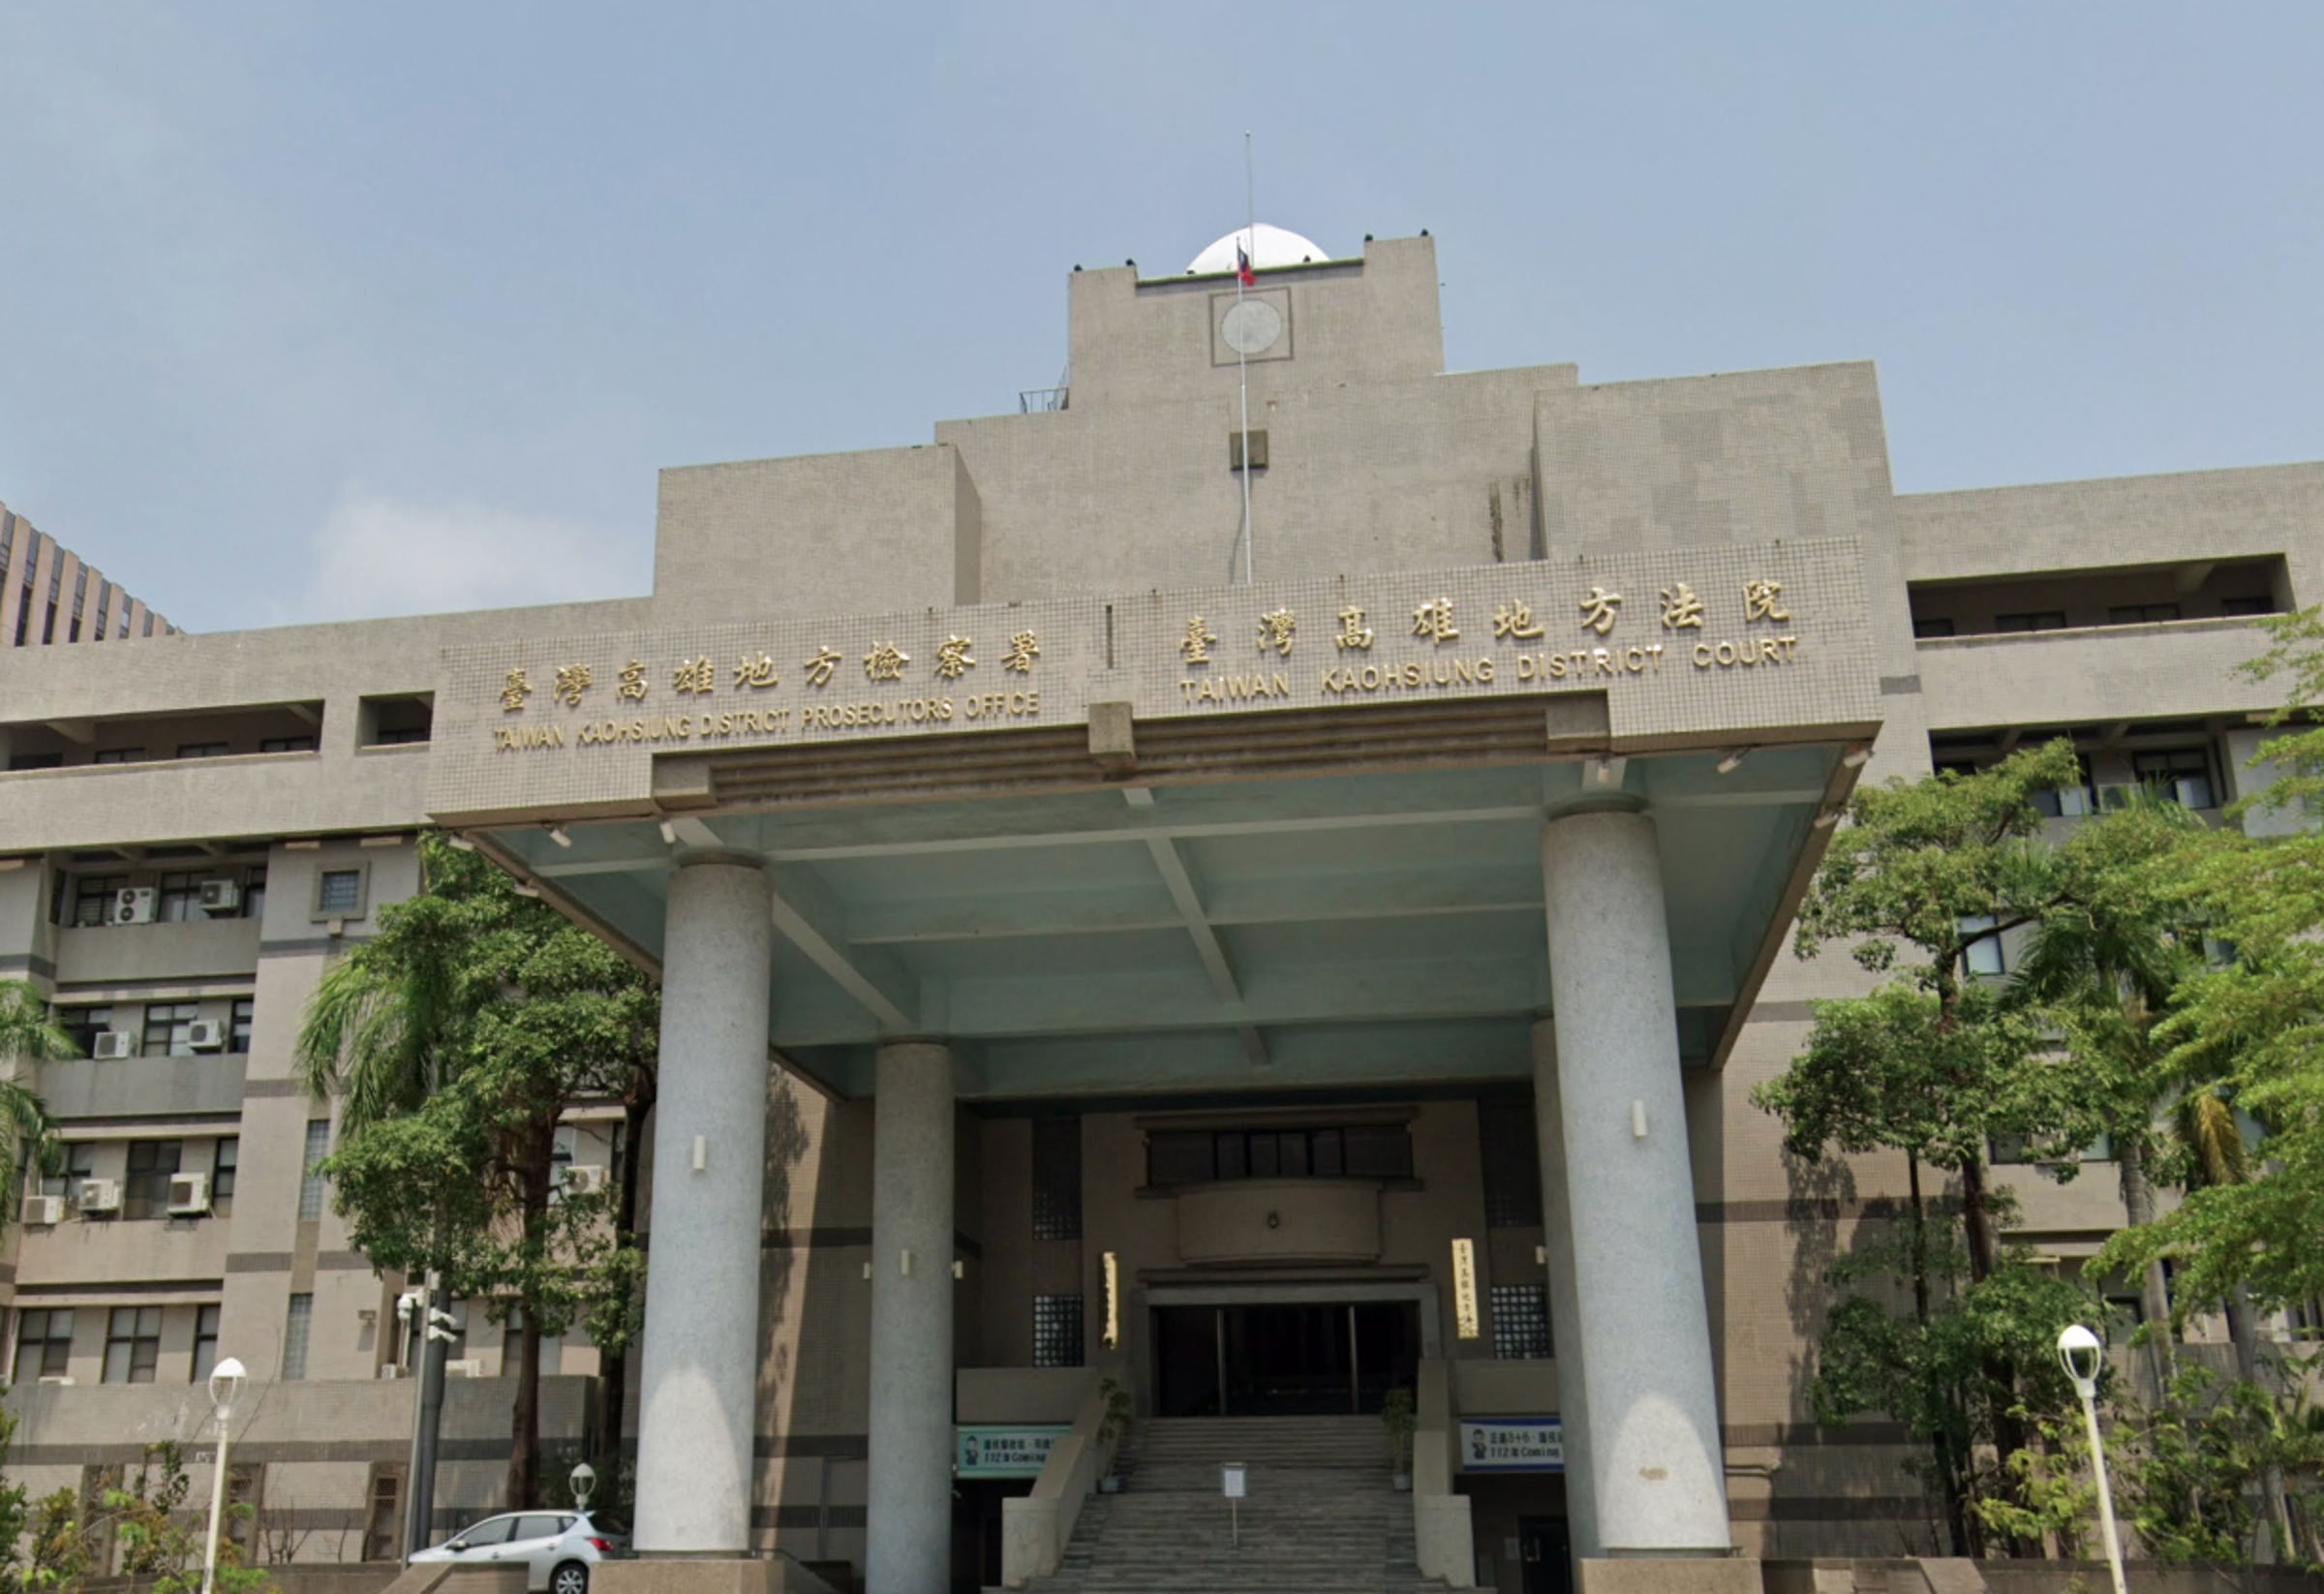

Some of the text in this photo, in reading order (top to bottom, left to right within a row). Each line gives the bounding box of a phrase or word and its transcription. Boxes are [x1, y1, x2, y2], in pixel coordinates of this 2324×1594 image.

[1179, 579, 1790, 664] 臺灣高雄地方法院
[499, 629, 1041, 713] 臺灣高雄地方檢察署
[1179, 635, 1797, 702] TAIWAN KAOHSIUNG DISTRICT COURT
[495, 692, 1040, 751] TAIWAN KAOHSIUNG DISTRICT PROSECUTORS OFFICE
